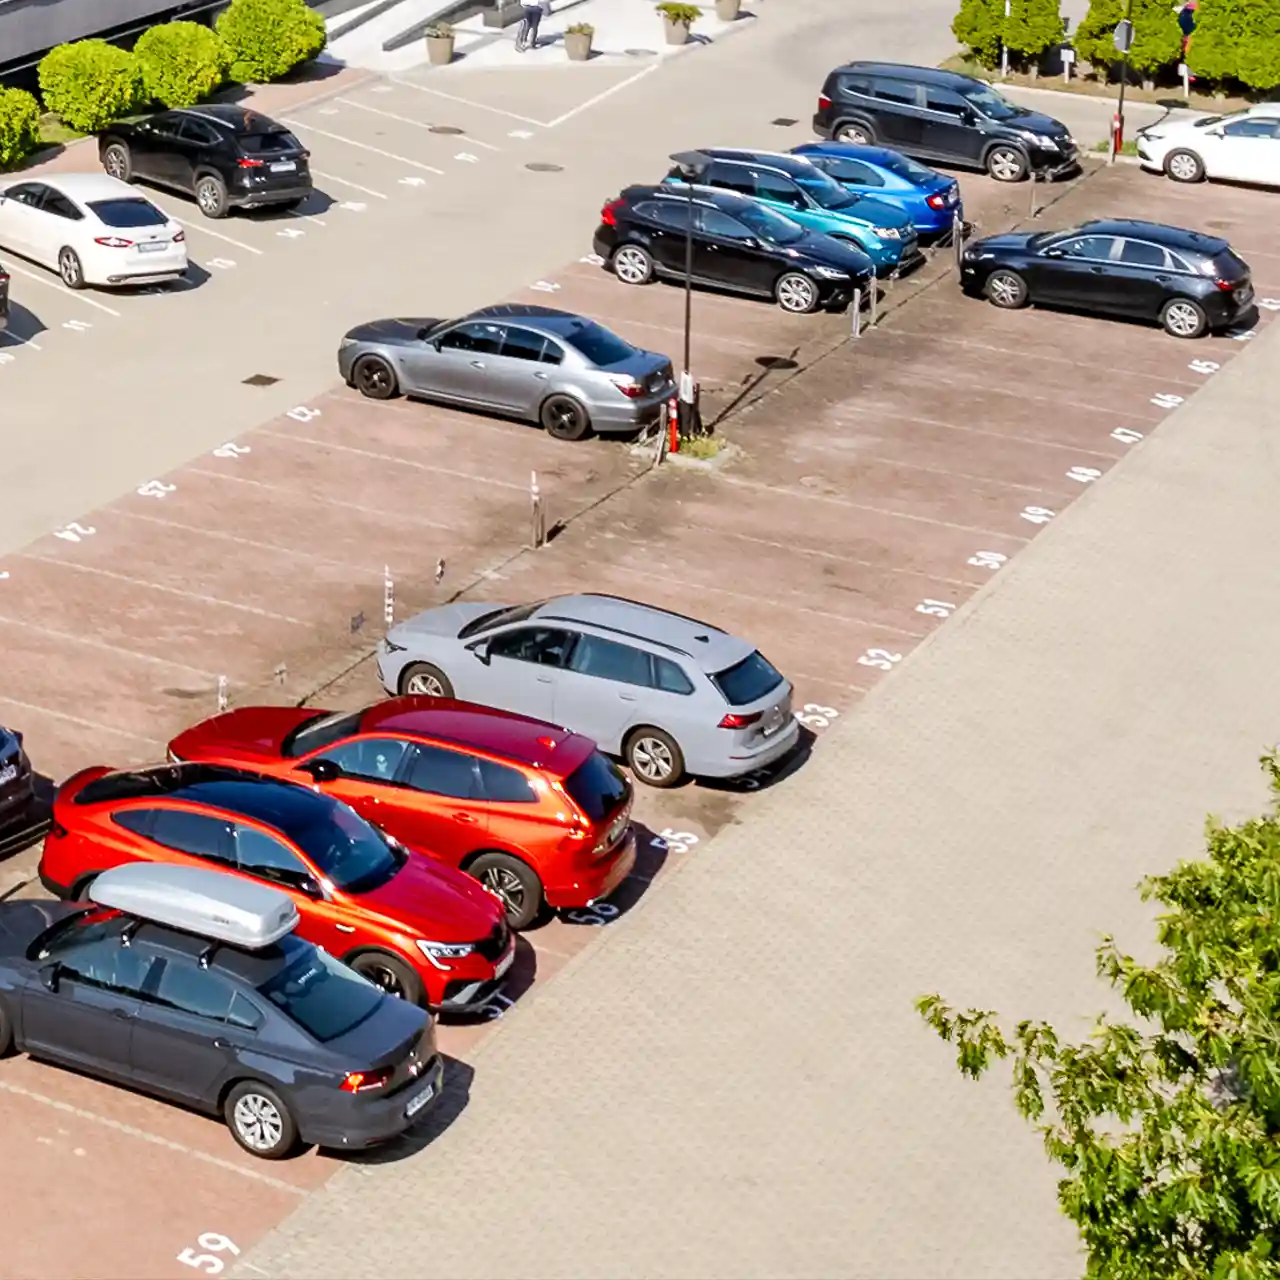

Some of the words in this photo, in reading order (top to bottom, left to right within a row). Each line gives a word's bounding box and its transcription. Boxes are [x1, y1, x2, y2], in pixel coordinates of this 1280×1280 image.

[1110, 426, 1144, 444] 47
[1065, 465, 1102, 483] 48
[137, 480, 177, 498] 25
[1020, 505, 1056, 524] 49
[53, 522, 96, 542] 24
[967, 550, 1007, 570] 50
[915, 598, 956, 618] 51
[856, 648, 903, 671] 52
[794, 703, 839, 728] 53
[650, 828, 699, 854] 55
[176, 1232, 241, 1274] 59
